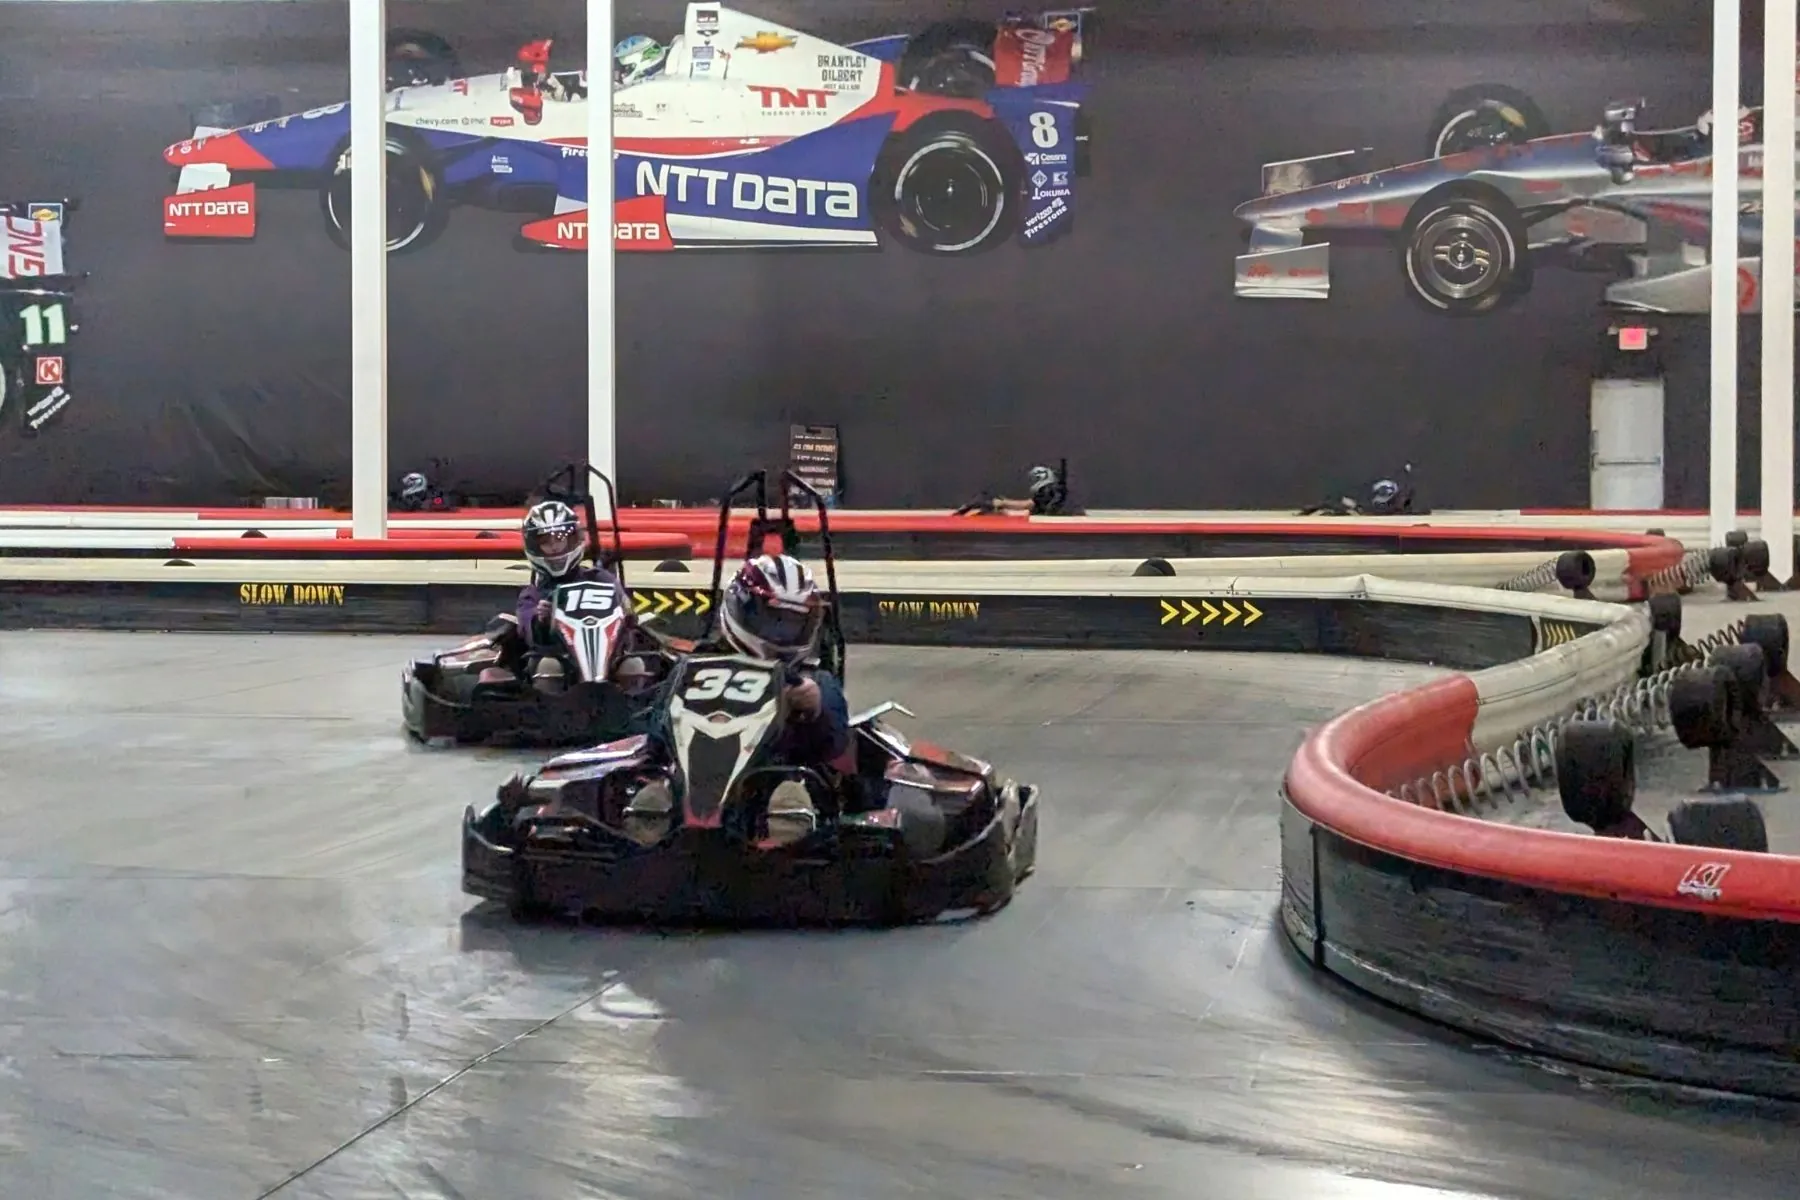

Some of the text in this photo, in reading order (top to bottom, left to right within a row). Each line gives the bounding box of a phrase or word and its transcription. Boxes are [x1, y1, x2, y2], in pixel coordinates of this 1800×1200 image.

[817, 55, 867, 68] BRANTLEY
[821, 69, 863, 82] GILBERT
[746, 85, 839, 108] TNT
[415, 117, 459, 126] chevy.com
[1029, 112, 1059, 148] 8
[636, 160, 728, 206] NTT
[169, 203, 203, 217] NTT
[1024, 205, 1068, 238] Firestone
[19, 304, 65, 344] 11
[240, 583, 345, 606] SLOW DOWN
[565, 589, 615, 611] 15
[878, 601, 980, 621] SLOW DOWN
[684, 668, 771, 702] 33
